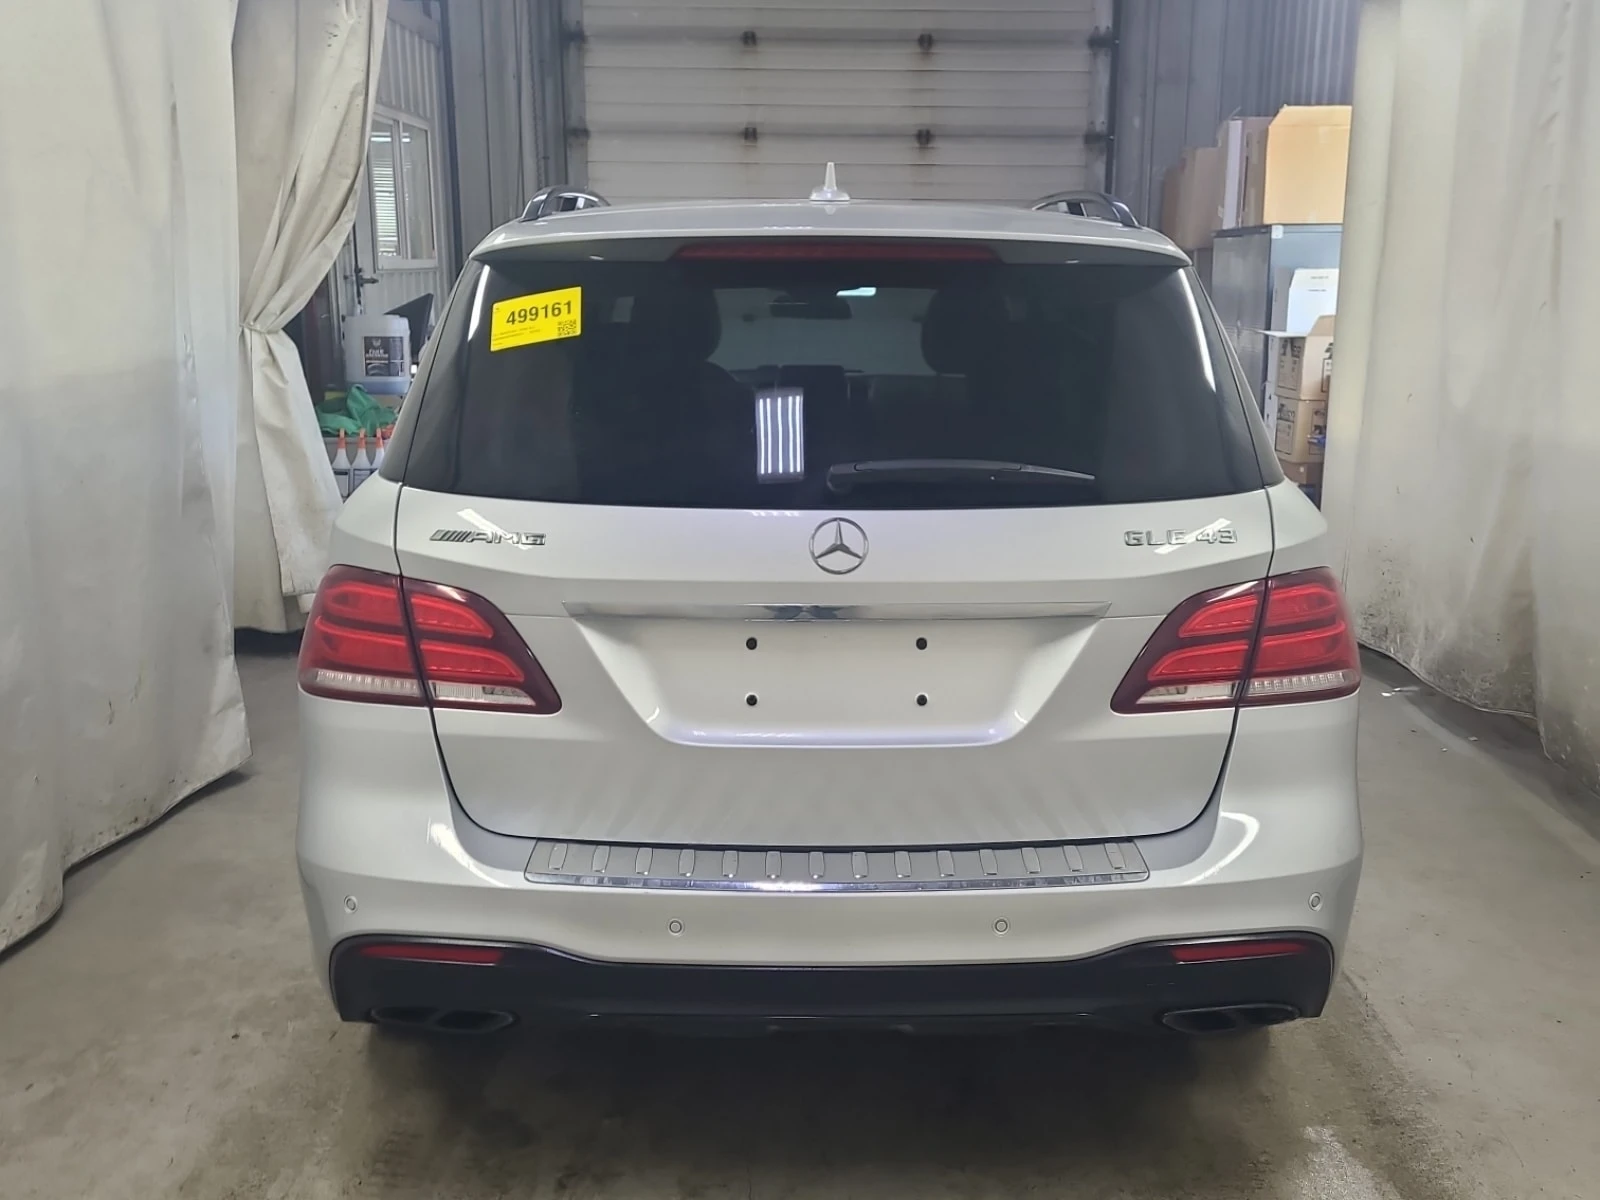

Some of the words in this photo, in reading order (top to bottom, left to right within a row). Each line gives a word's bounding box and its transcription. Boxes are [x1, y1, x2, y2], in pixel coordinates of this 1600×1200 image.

[506, 300, 572, 325] 499161
[466, 530, 546, 545] AMG
[1124, 529, 1187, 546] GLE
[1196, 528, 1237, 544] 43
